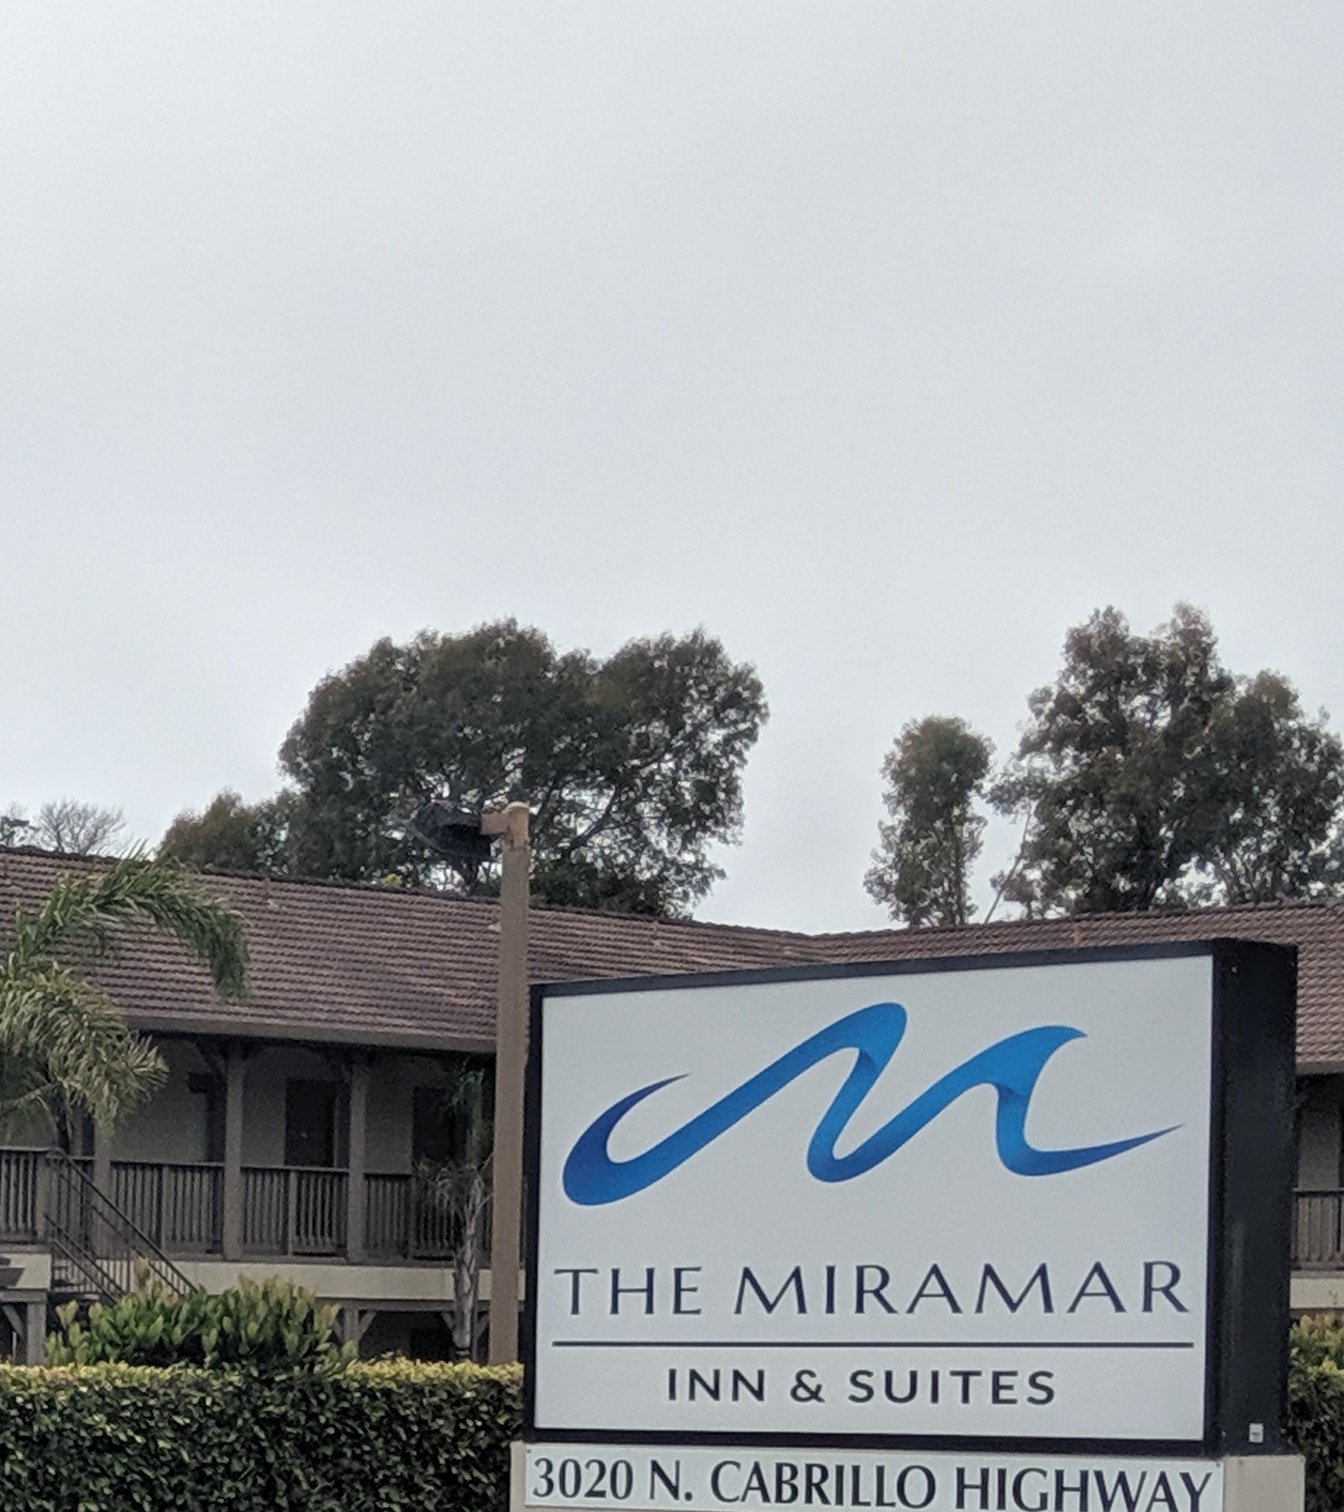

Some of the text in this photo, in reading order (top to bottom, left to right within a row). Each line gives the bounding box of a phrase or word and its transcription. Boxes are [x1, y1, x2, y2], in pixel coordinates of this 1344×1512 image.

[553, 1260, 1190, 1316] THE MIRAMAR
[668, 1368, 1056, 1406] INN & SUITES
[532, 1457, 634, 1500] 3020
[649, 1459, 693, 1502] N.
[710, 1461, 937, 1509] CABRILLO
